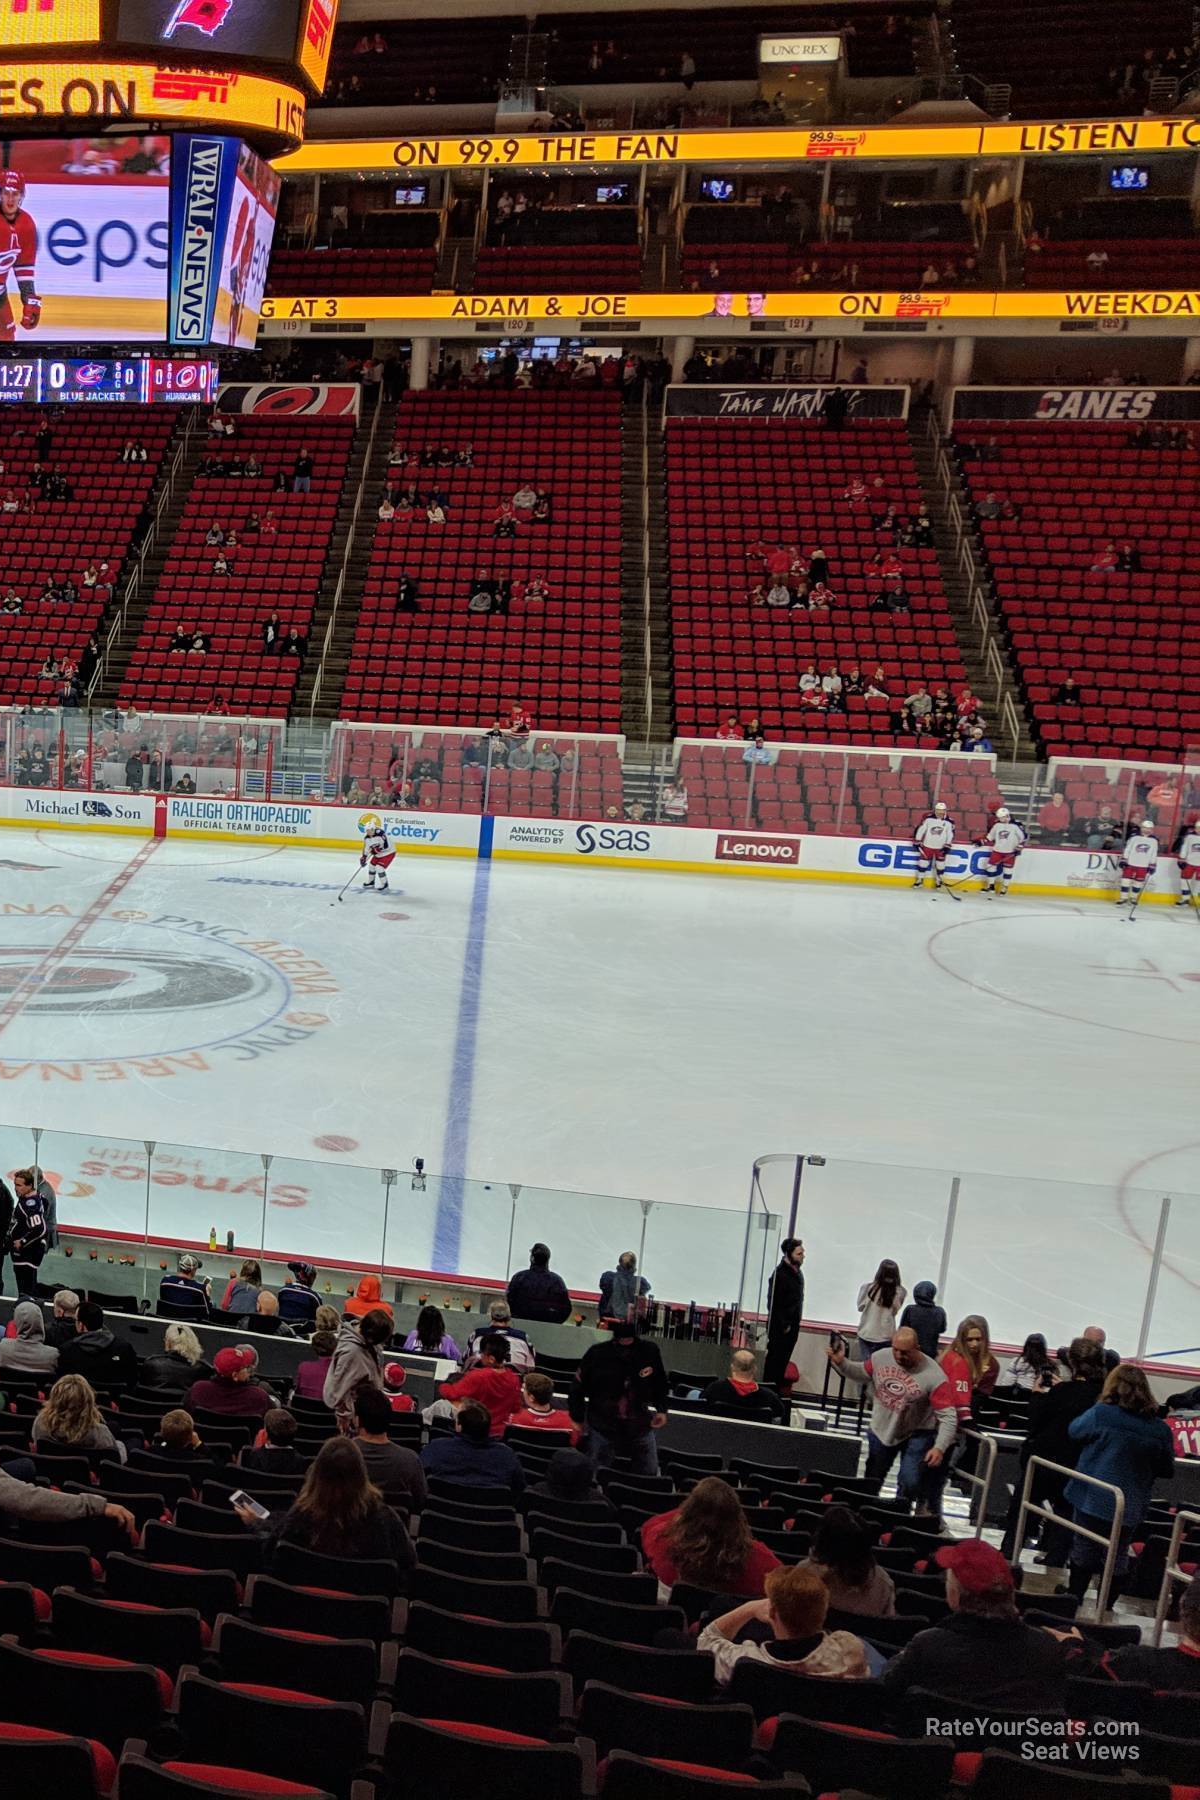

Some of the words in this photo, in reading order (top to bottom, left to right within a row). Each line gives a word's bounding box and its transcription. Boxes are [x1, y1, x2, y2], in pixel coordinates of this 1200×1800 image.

[771, 45, 801, 56] UNC
[803, 44, 828, 55] REX
[61, 79, 136, 118] ON
[809, 132, 834, 143] 99.9
[1019, 123, 1138, 152] LISTEN
[394, 143, 440, 166] ON
[459, 139, 520, 164] 99.9
[538, 138, 595, 162] THE
[616, 136, 679, 159] FAN
[188, 144, 220, 227] WRAL
[36, 217, 169, 282] eps
[181, 238, 212, 336] NEWS
[290, 301, 321, 318] AT
[325, 301, 338, 317] 3
[451, 297, 530, 317] ADAM
[545, 297, 562, 316] &
[577, 296, 627, 316] JOE
[839, 295, 882, 315] ON
[1066, 294, 1200, 314] WEEKDA
[283, 321, 297, 330] 119
[507, 319, 523, 330] 120
[788, 318, 805, 329] 121
[1102, 318, 1120, 329] 122
[50, 362, 66, 389] 0
[125, 368, 134, 385] 0
[60, 392, 84, 401] BLUE
[86, 392, 126, 401] JACKETS
[719, 391, 764, 415] TAKE
[1035, 391, 1157, 419] CANES
[25, 798, 80, 816] Michael
[115, 805, 141, 820] Son
[172, 800, 223, 820] RALEIGH
[226, 803, 311, 825] ORTHOPAEDIC
[183, 819, 224, 831] OFFICIAL
[226, 822, 251, 832] TEAM
[255, 823, 298, 834] DOCTORS
[395, 817, 426, 826] Education
[511, 826, 564, 837] ANALYTICS
[383, 823, 440, 842] Lottery
[509, 834, 551, 844] POWERED
[552, 837, 563, 845] BY
[599, 828, 650, 852] sas
[722, 839, 793, 858] Lenovo
[858, 843, 1003, 878] GECO
[151, 913, 248, 940] PNC
[237, 938, 341, 994] ARENA
[211, 1024, 318, 1062] PNC
[29, 1214, 42, 1227] 10
[955, 1380, 969, 1393] 20
[1178, 1430, 1200, 1457] 11
